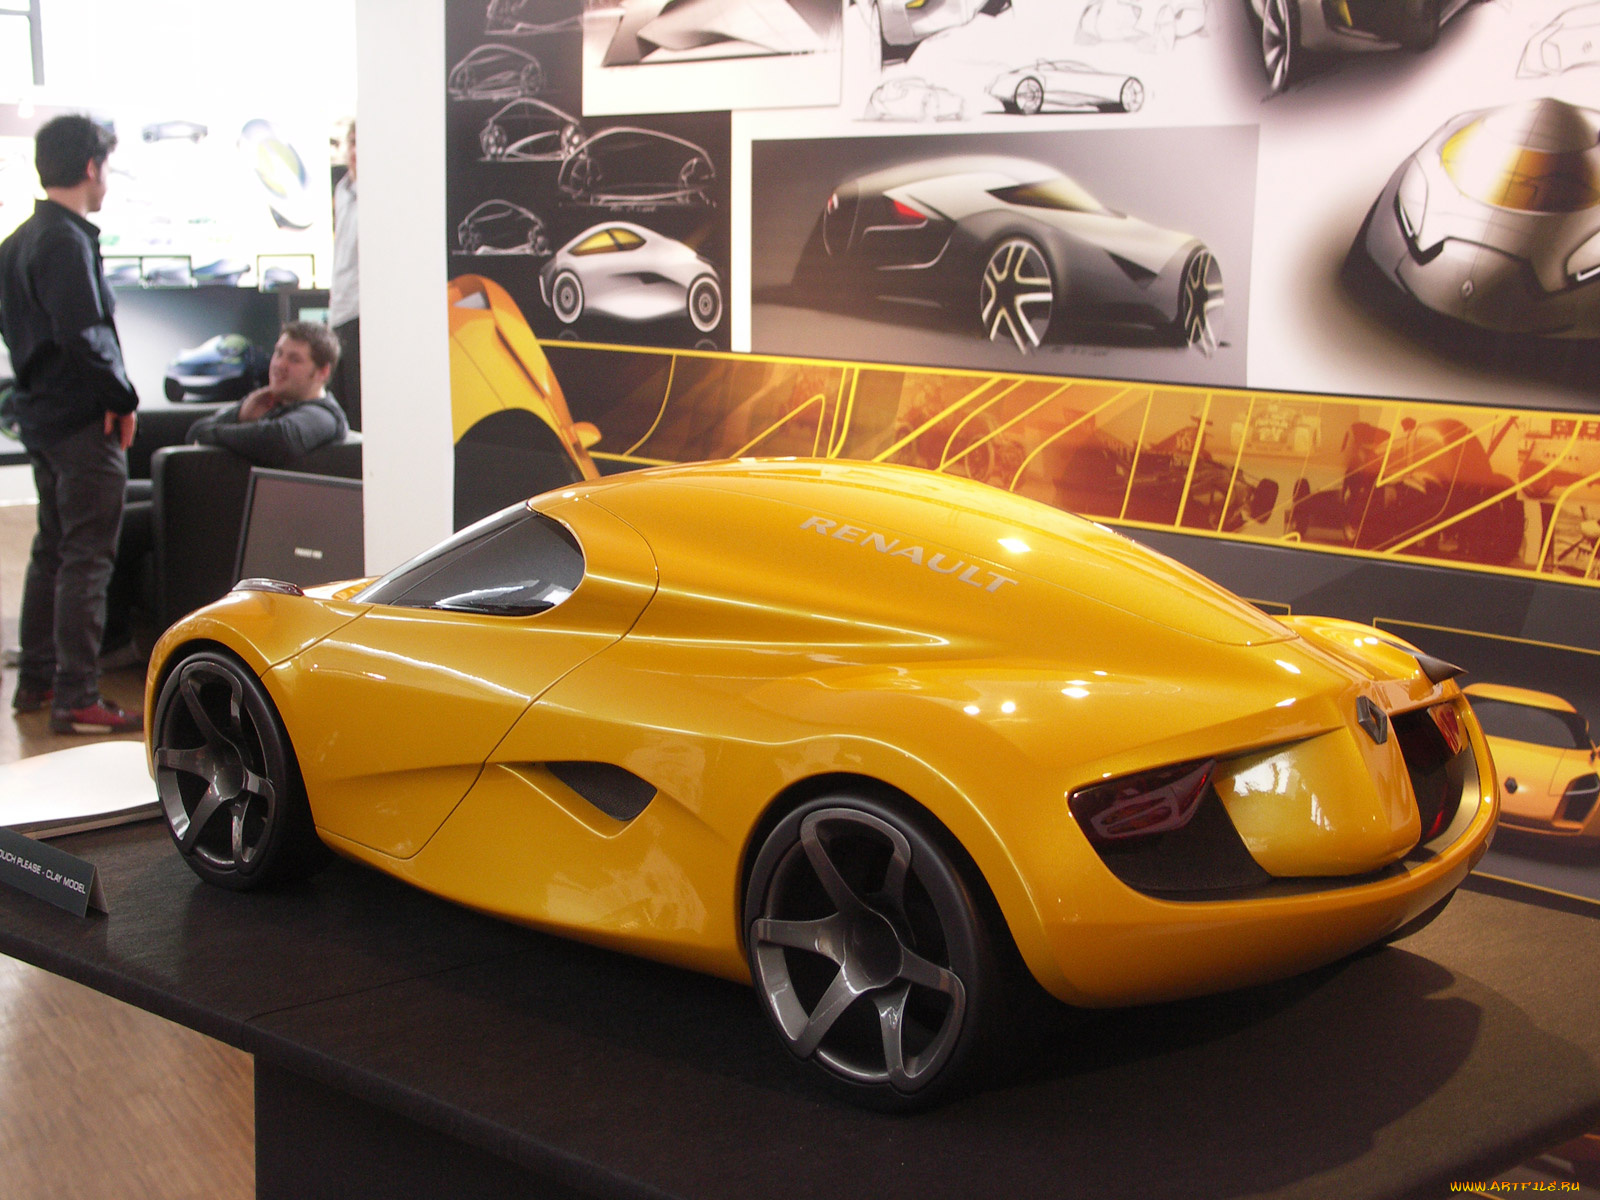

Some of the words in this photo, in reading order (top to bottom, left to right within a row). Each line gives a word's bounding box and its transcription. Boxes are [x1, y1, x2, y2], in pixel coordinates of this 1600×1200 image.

[800, 516, 1019, 593] RENAULT
[16, 857, 41, 874] PLEASE
[45, 869, 63, 883] CLAY
[63, 876, 86, 894] MODEL
